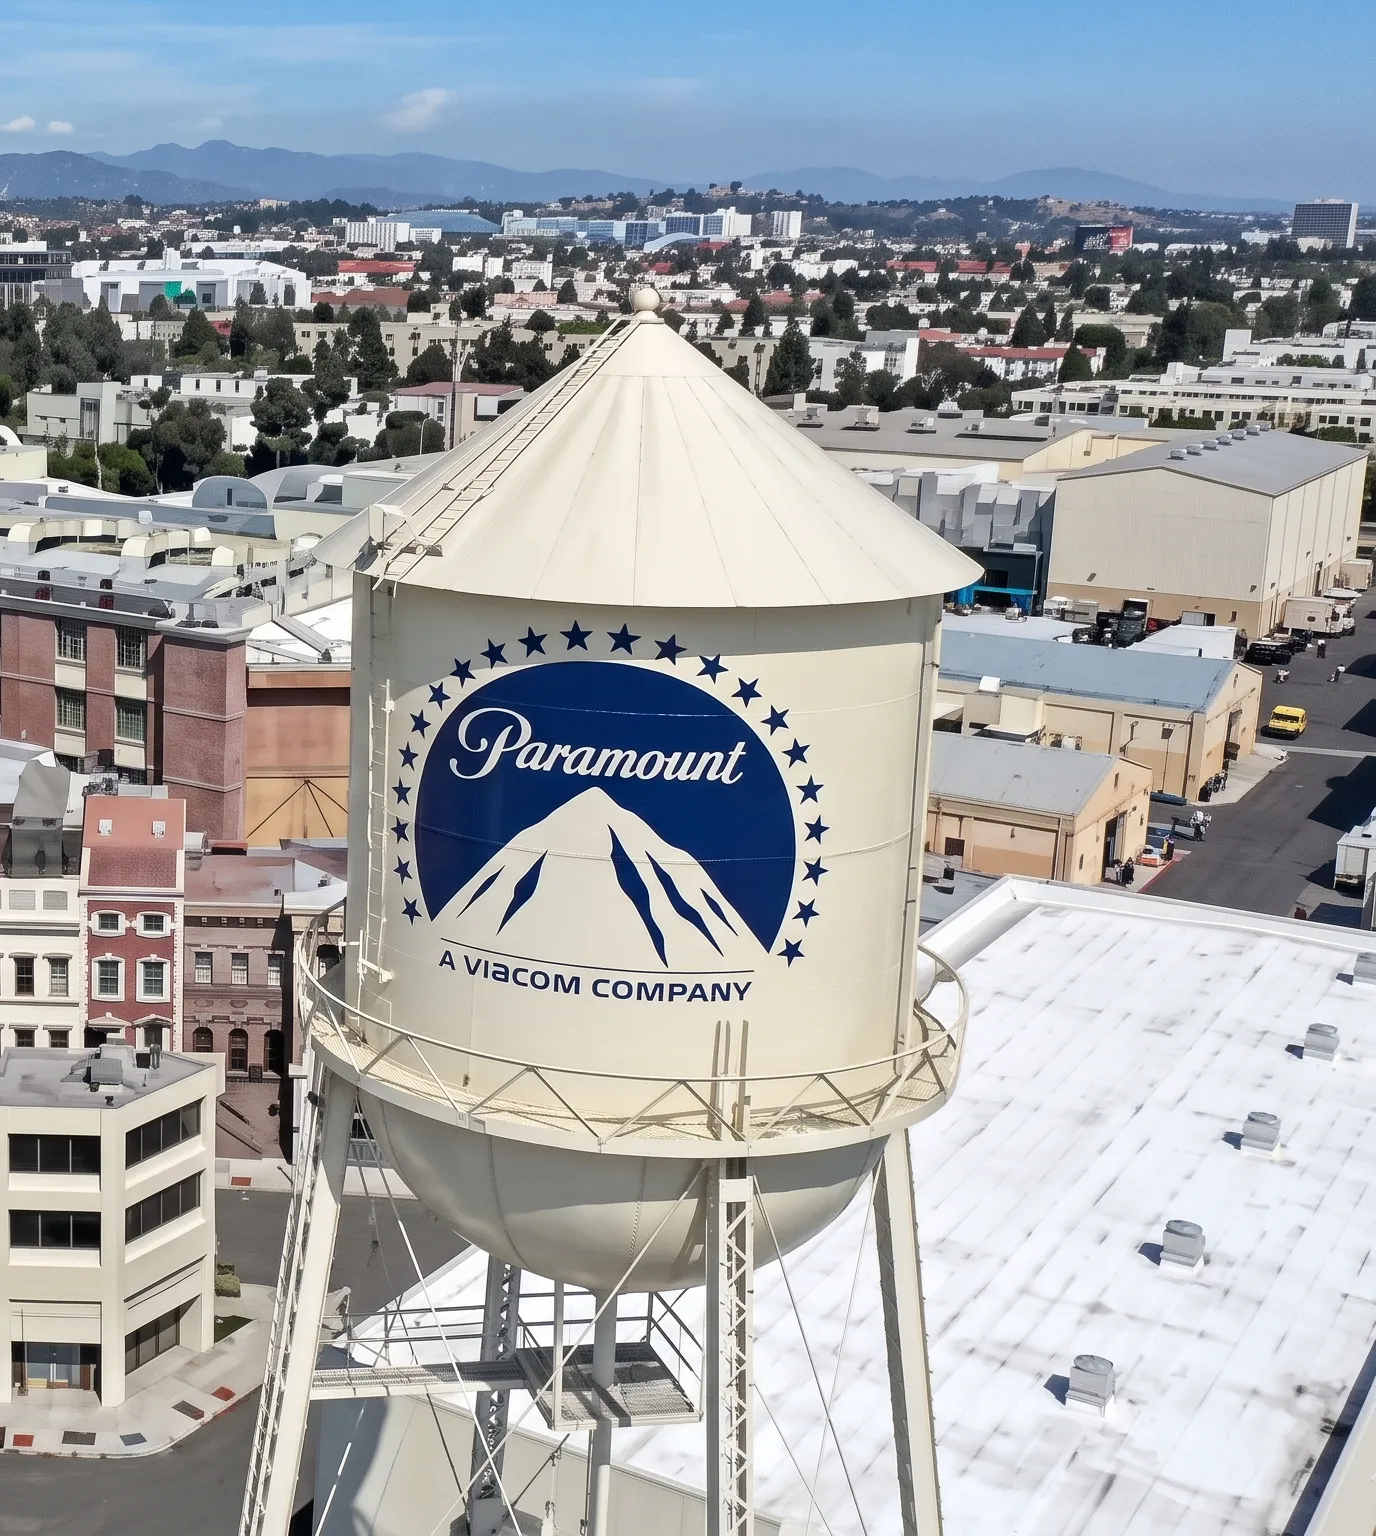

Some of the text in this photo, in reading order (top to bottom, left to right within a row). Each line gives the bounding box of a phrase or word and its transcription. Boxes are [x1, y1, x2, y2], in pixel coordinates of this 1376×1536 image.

[449, 707, 746, 785] Paramount
[438, 949, 456, 971] A
[591, 978, 753, 1003] COMPANY
